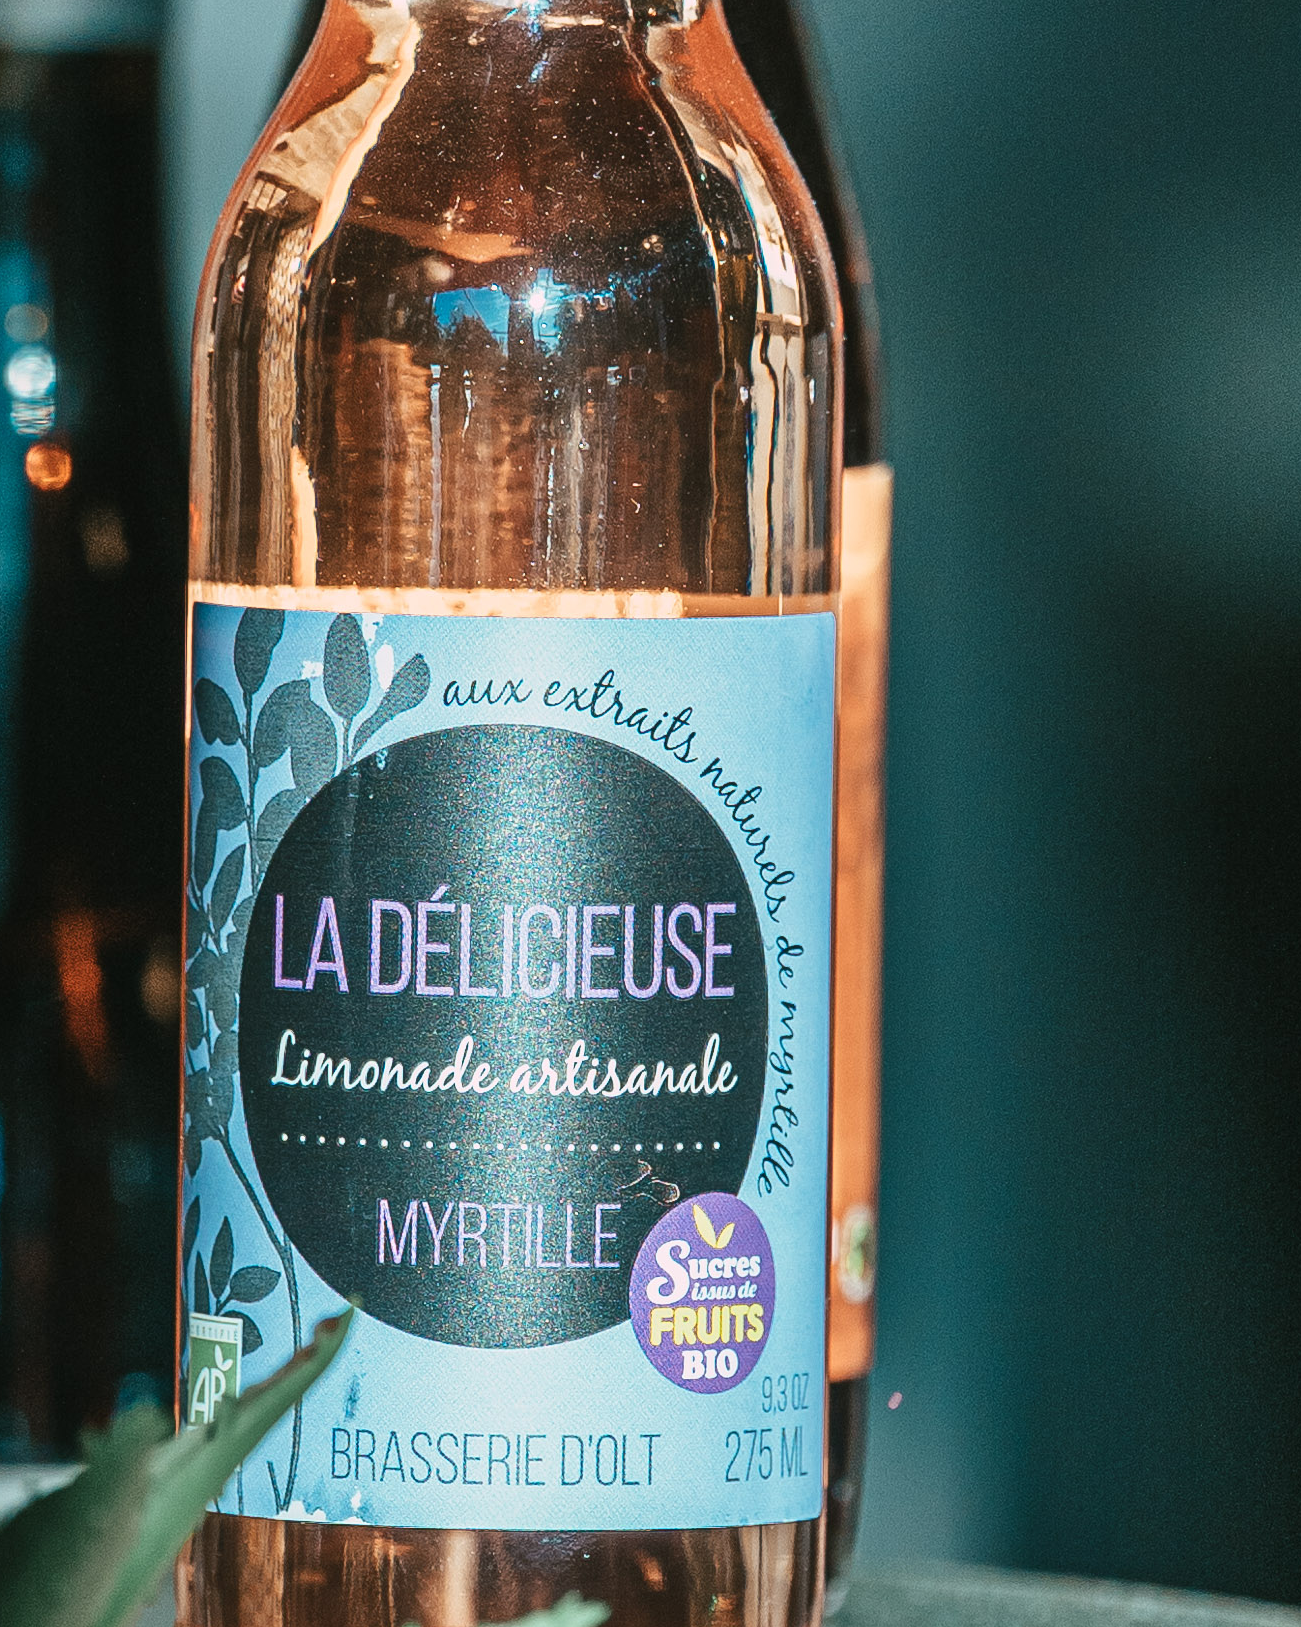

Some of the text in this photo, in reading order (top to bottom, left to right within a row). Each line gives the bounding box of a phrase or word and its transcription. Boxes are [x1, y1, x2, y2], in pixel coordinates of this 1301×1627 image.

[273, 883, 737, 1000] LA DÉLICIEUSE
[442, 669, 804, 1198] aux extraits naturels de myrtille
[269, 1028, 739, 1097] Limonade artisanale
[377, 1197, 622, 1269] MYRTILLE
[647, 1239, 762, 1305] Sucres
[691, 1280, 758, 1302] issus de
[649, 1303, 765, 1346] FRUITS
[681, 1348, 739, 1380] BIO
[761, 1372, 810, 1415] 9,3 OZ
[330, 1426, 662, 1487] BRASSERIE D'OLT
[724, 1424, 809, 1483] 275 ML
